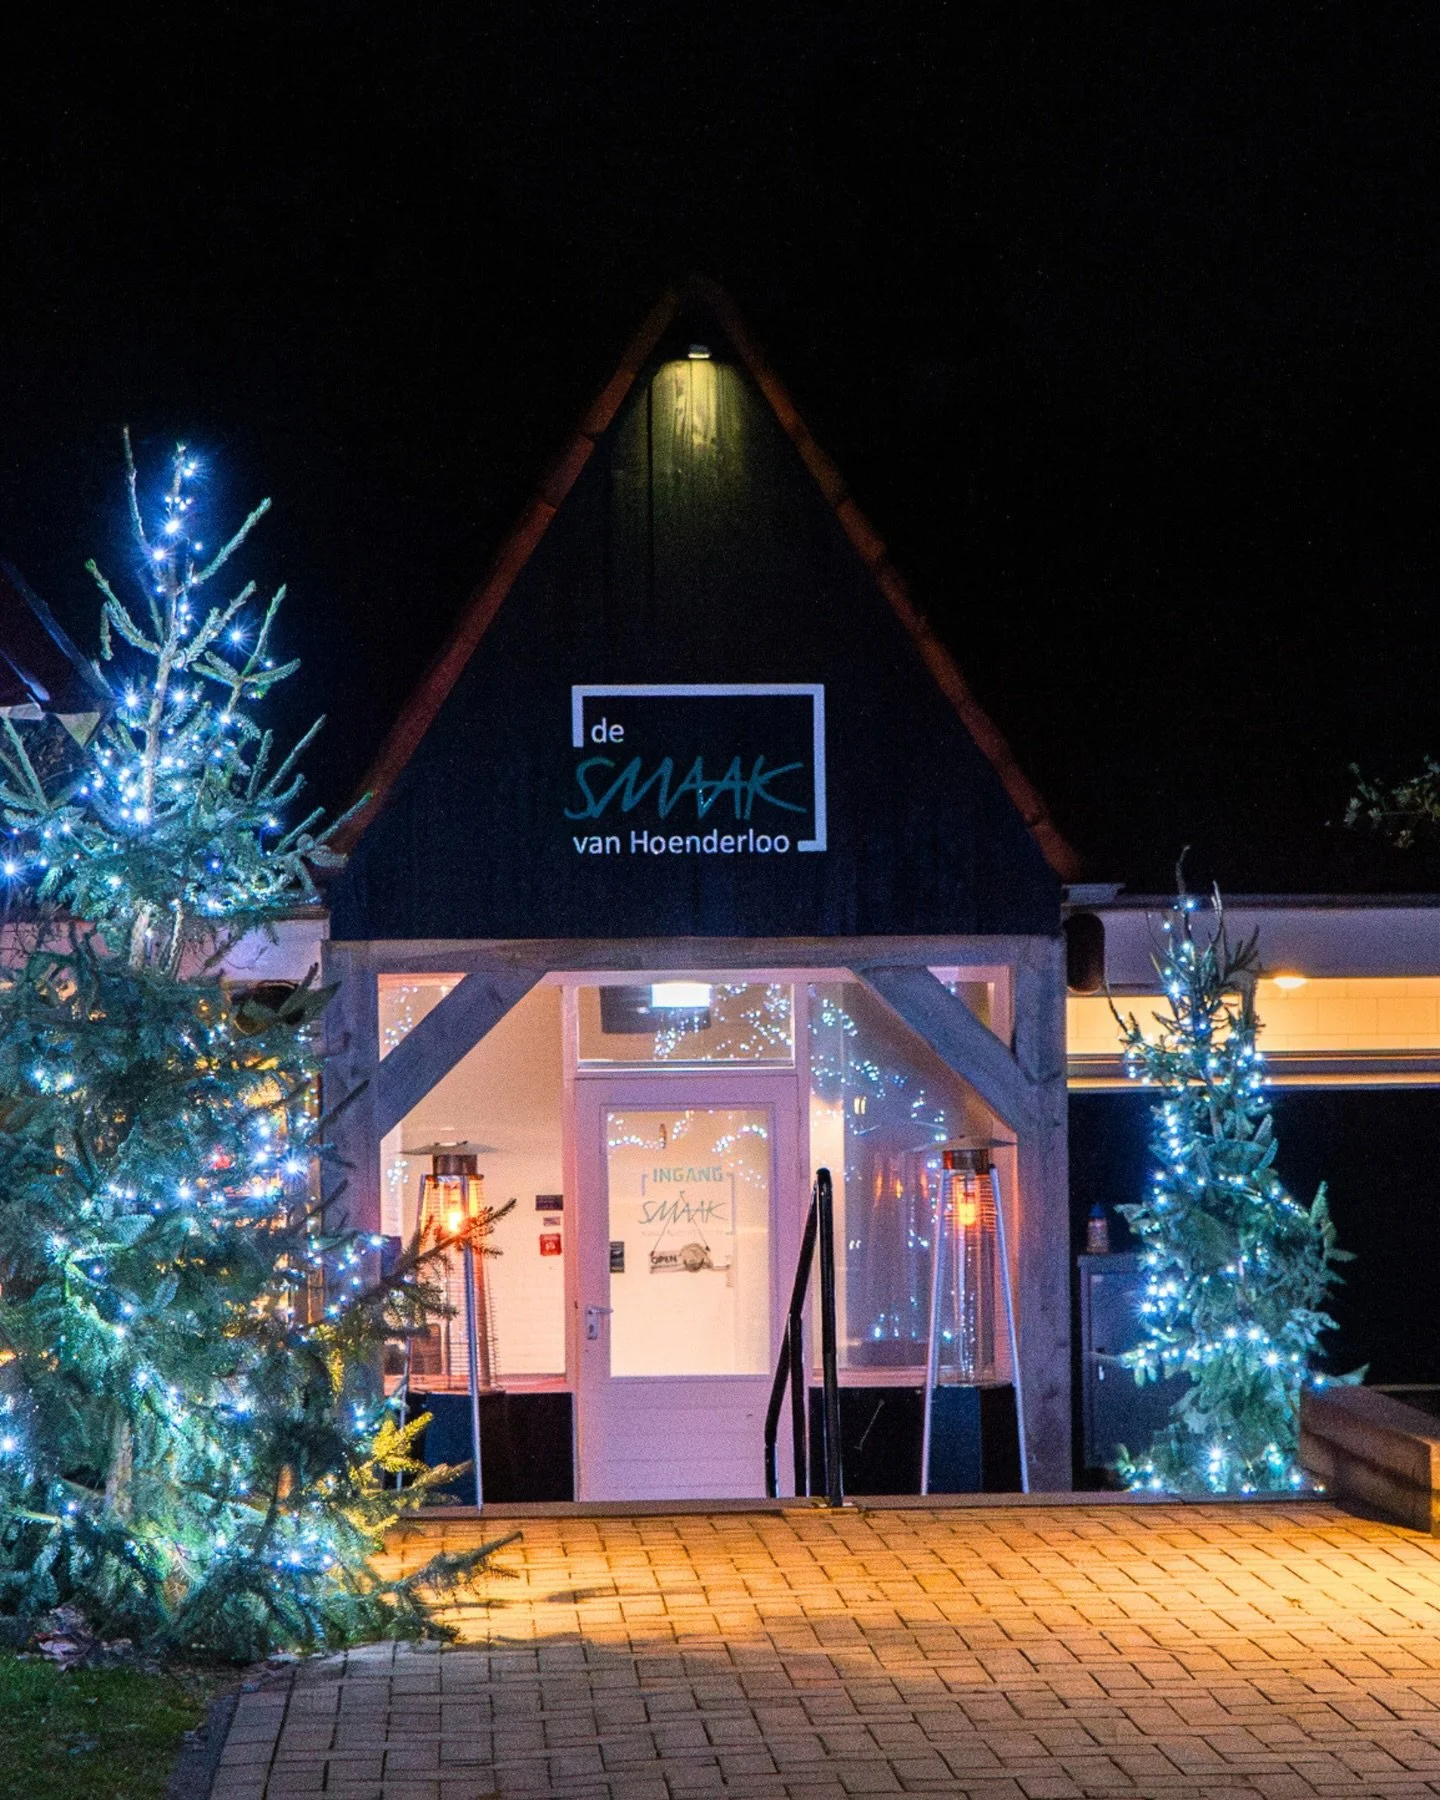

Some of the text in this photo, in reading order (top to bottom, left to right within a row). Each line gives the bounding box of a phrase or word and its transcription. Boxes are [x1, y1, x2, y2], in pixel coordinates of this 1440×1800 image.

[590, 717, 625, 743] de
[563, 754, 808, 820] SMAAK
[573, 828, 790, 855] van Hoenderloo
[652, 1167, 724, 1183] INGANG
[638, 1200, 729, 1224] SMAAK
[651, 1254, 678, 1265] OPEN
